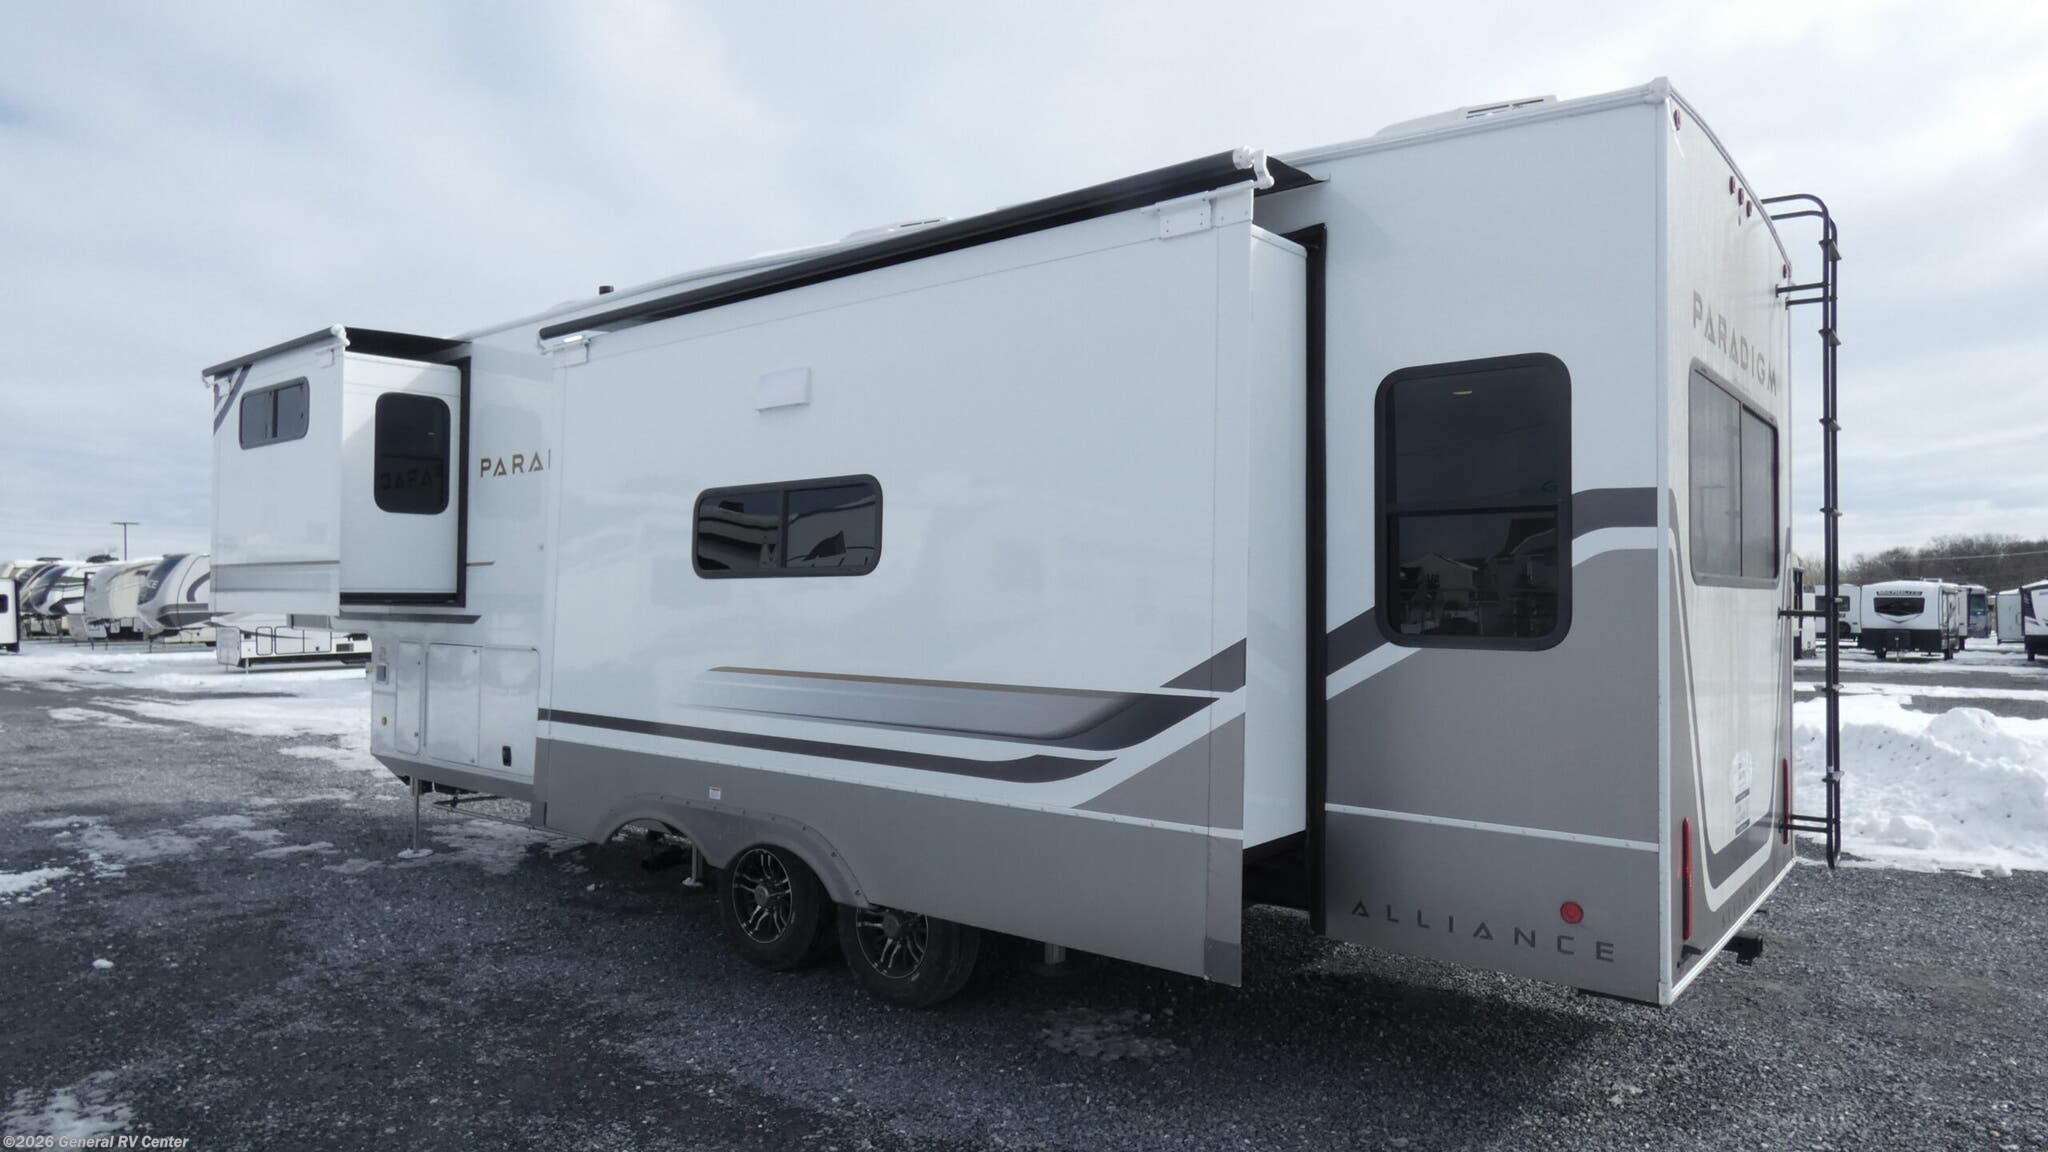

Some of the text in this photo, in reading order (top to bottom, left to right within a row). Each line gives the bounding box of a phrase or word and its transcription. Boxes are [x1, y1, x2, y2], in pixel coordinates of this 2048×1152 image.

[1693, 288, 1777, 397] PARADIGM
[480, 448, 551, 478] PARA
[1351, 899, 1615, 963] ALLIANCE
